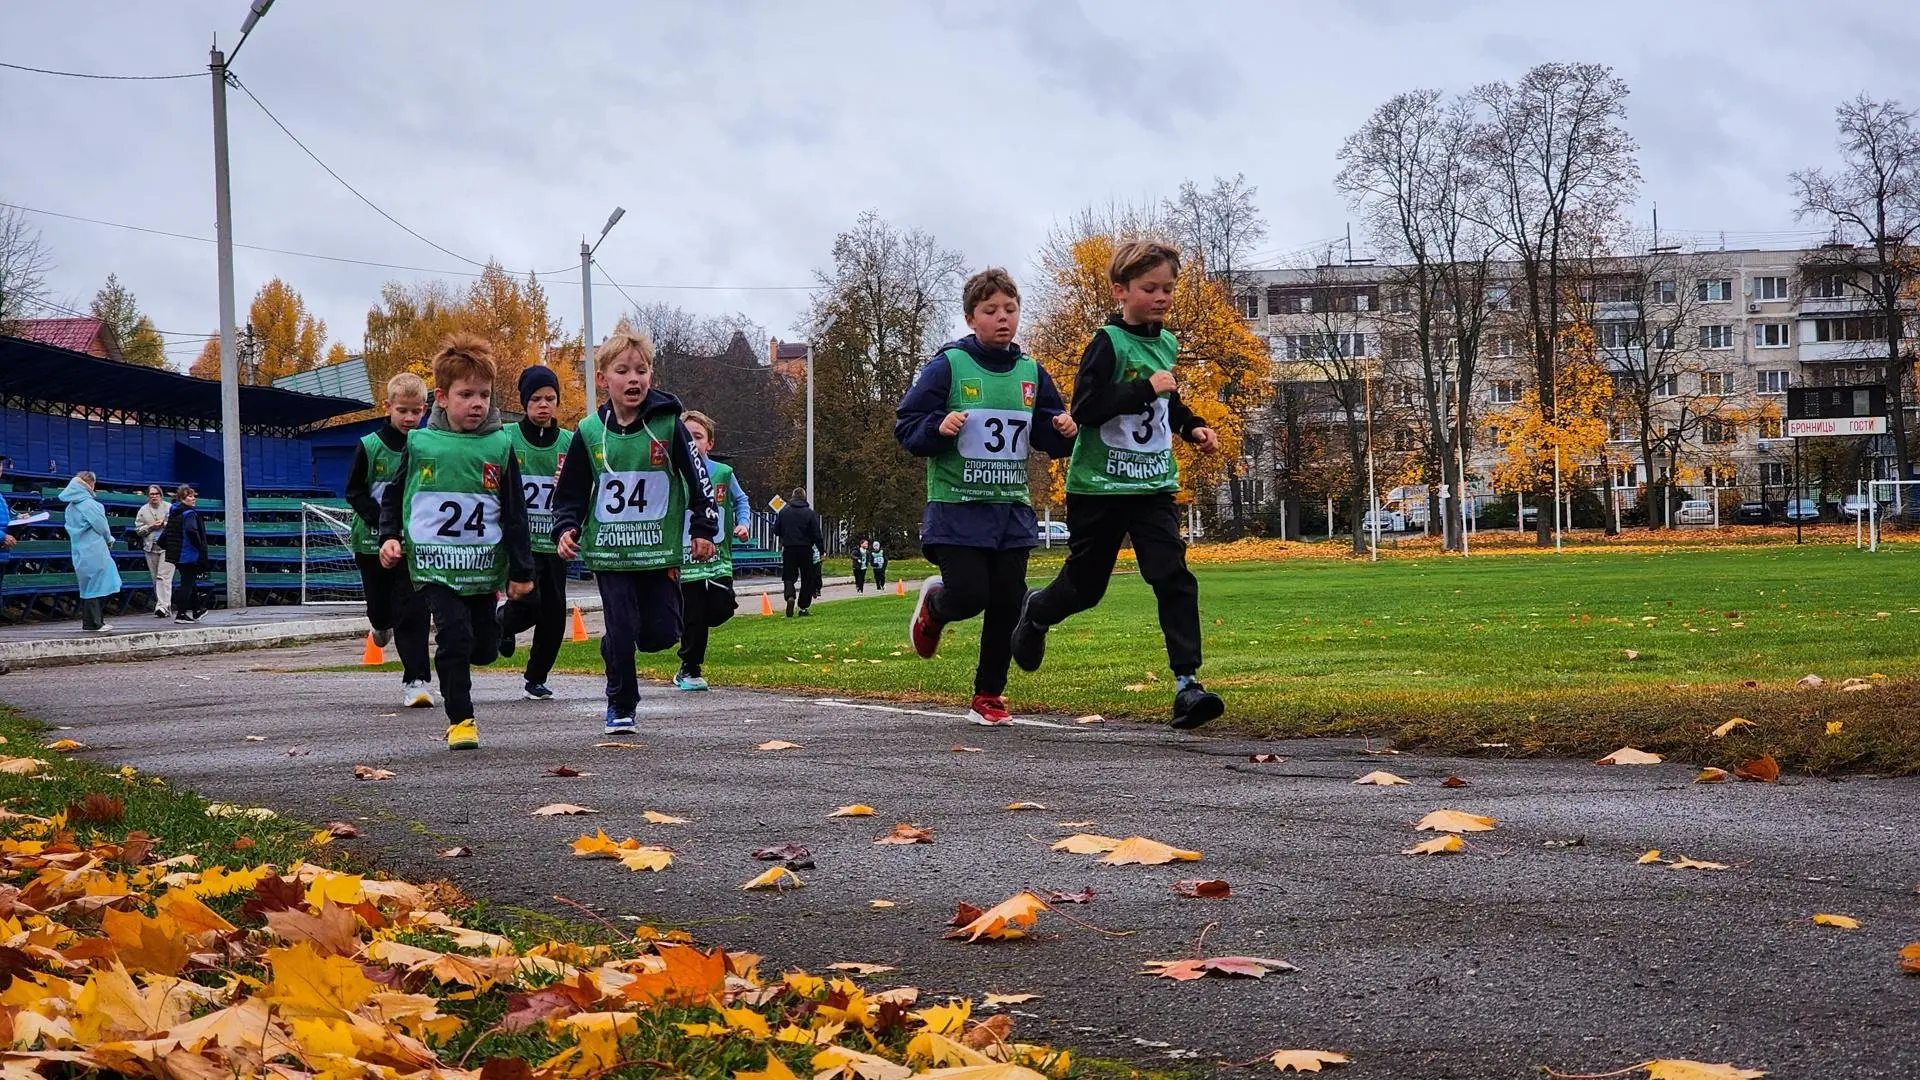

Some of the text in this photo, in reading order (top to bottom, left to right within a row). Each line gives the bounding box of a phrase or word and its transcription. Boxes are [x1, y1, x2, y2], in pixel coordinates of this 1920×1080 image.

[984, 417, 1027, 453] 37
[1791, 420, 1874, 433] БРОННИЦЫ ГОСТИ
[964, 460, 1017, 470] СПОРТИВНЫЙ
[523, 482, 554, 509] 27
[605, 479, 648, 514] 34
[436, 500, 486, 537] 24
[595, 530, 663, 547] БРОННИЦЫ
[415, 545, 475, 555] СПОРТИВНЫЙ
[416, 554, 495, 571] БРОННИЦЫ
